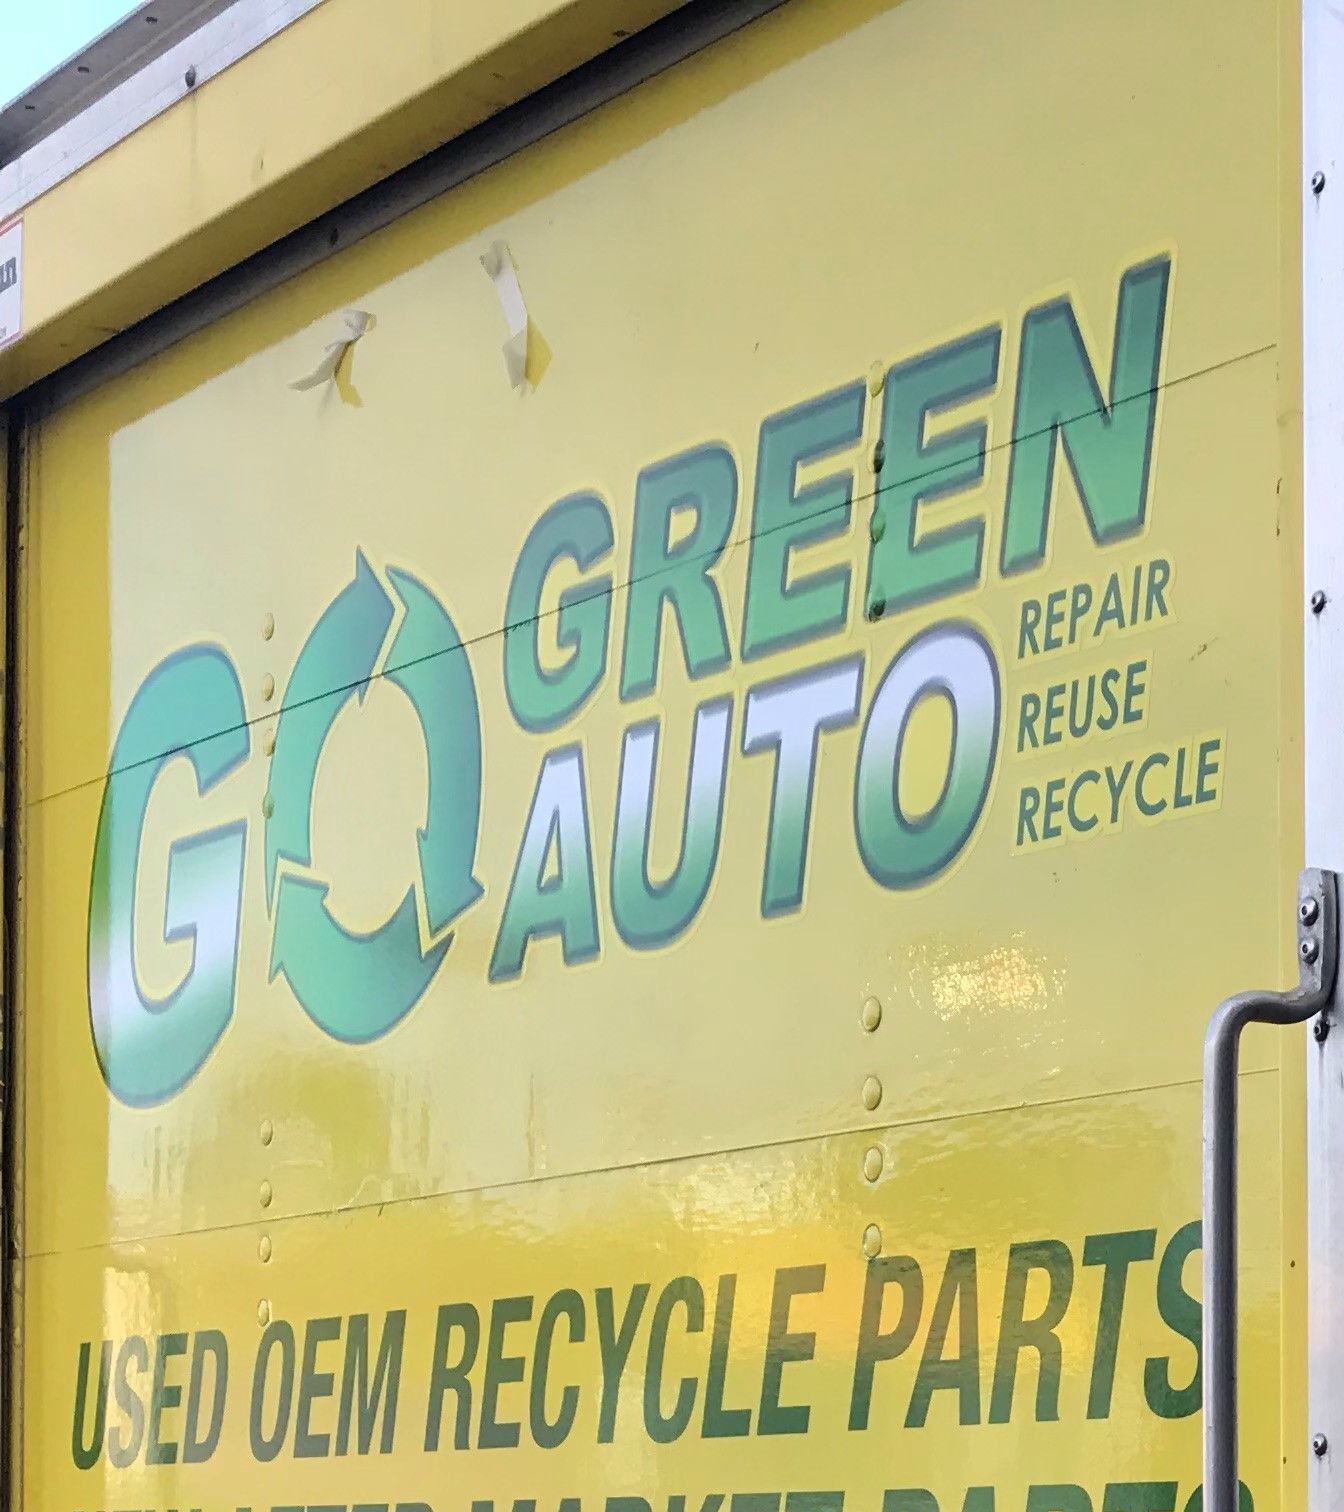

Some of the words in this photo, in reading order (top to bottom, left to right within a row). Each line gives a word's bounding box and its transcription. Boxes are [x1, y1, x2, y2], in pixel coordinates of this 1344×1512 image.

[504, 253, 1173, 733] GREEN
[1018, 557, 1172, 660] REPAIR
[1016, 738, 1222, 847] RECYCLE
[1018, 660, 1148, 752] REUSE
[489, 617, 1001, 985] AUTO
[72, 1330, 228, 1470] USED
[249, 1308, 407, 1463] OEM
[423, 1263, 826, 1454] RECYCLE
[847, 1219, 1203, 1431] PARTS
